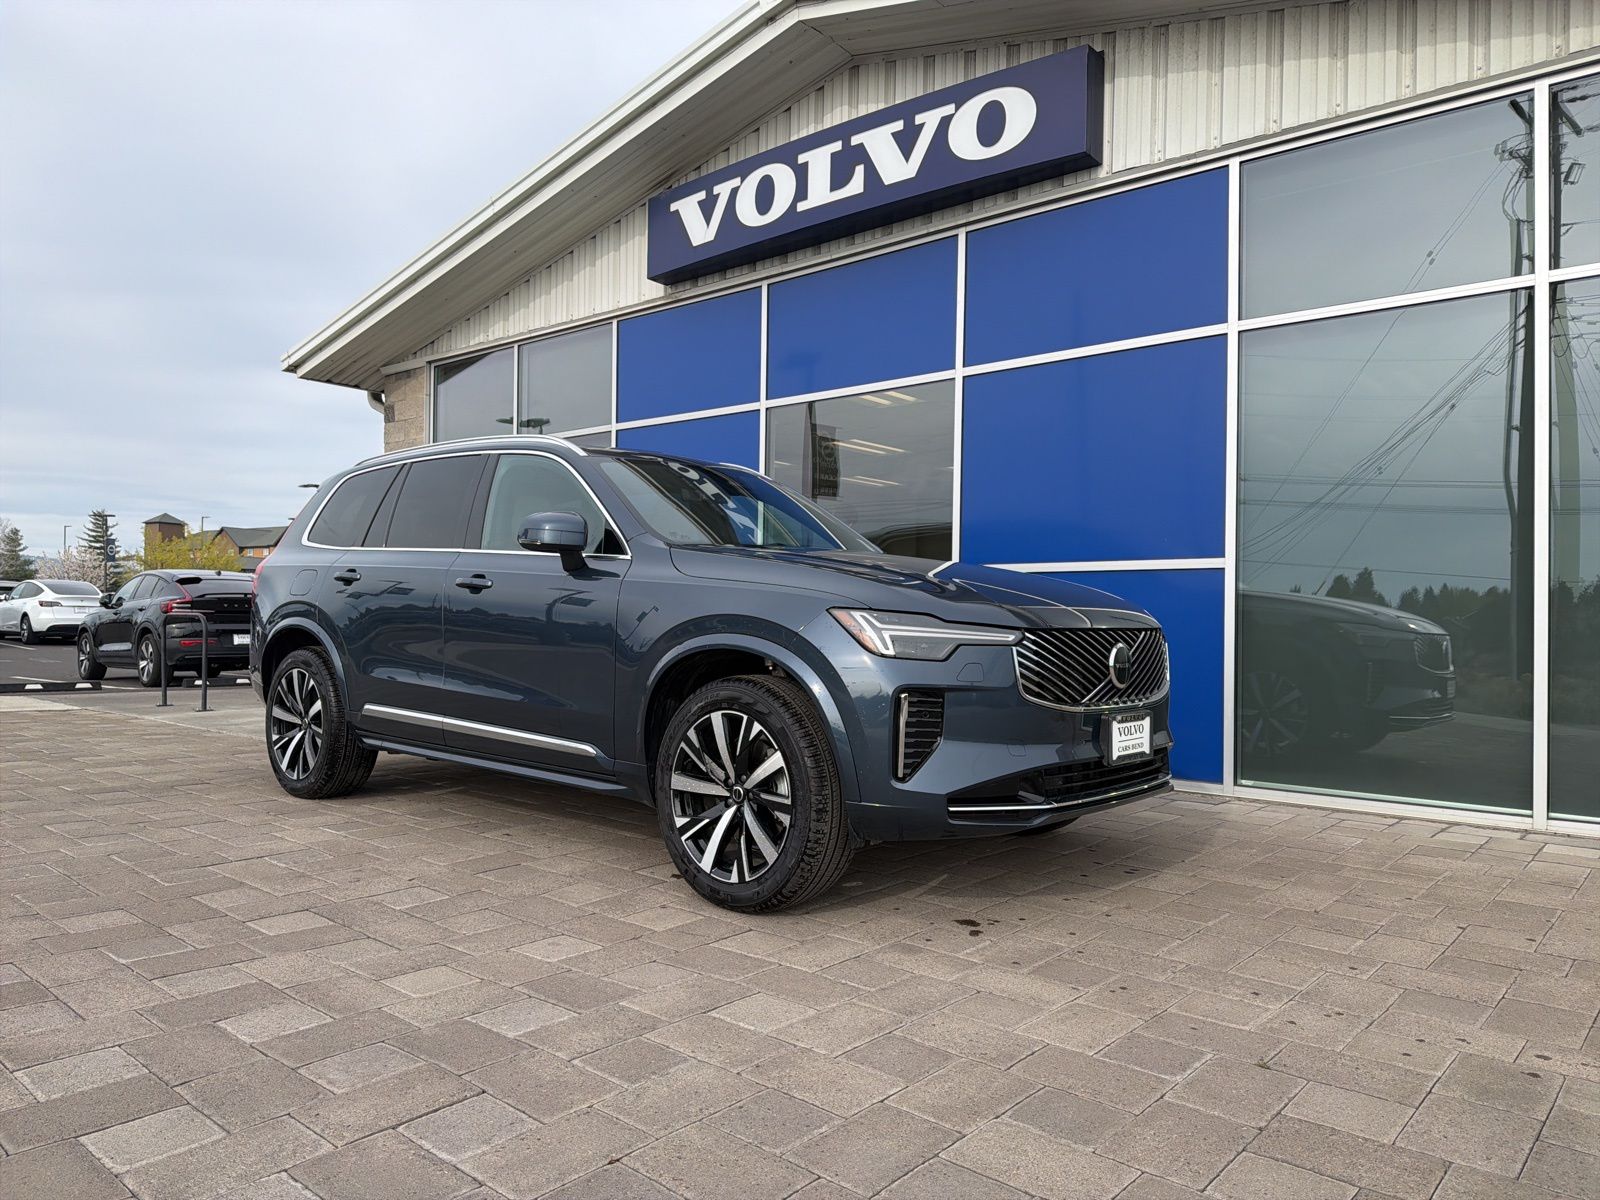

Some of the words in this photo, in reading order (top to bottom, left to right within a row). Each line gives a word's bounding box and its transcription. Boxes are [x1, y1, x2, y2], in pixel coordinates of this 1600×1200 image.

[670, 86, 1037, 247] VOLVO
[1118, 723, 1144, 737] VOLVO
[1118, 744, 1130, 752] CARS
[1132, 742, 1144, 750] BEND
